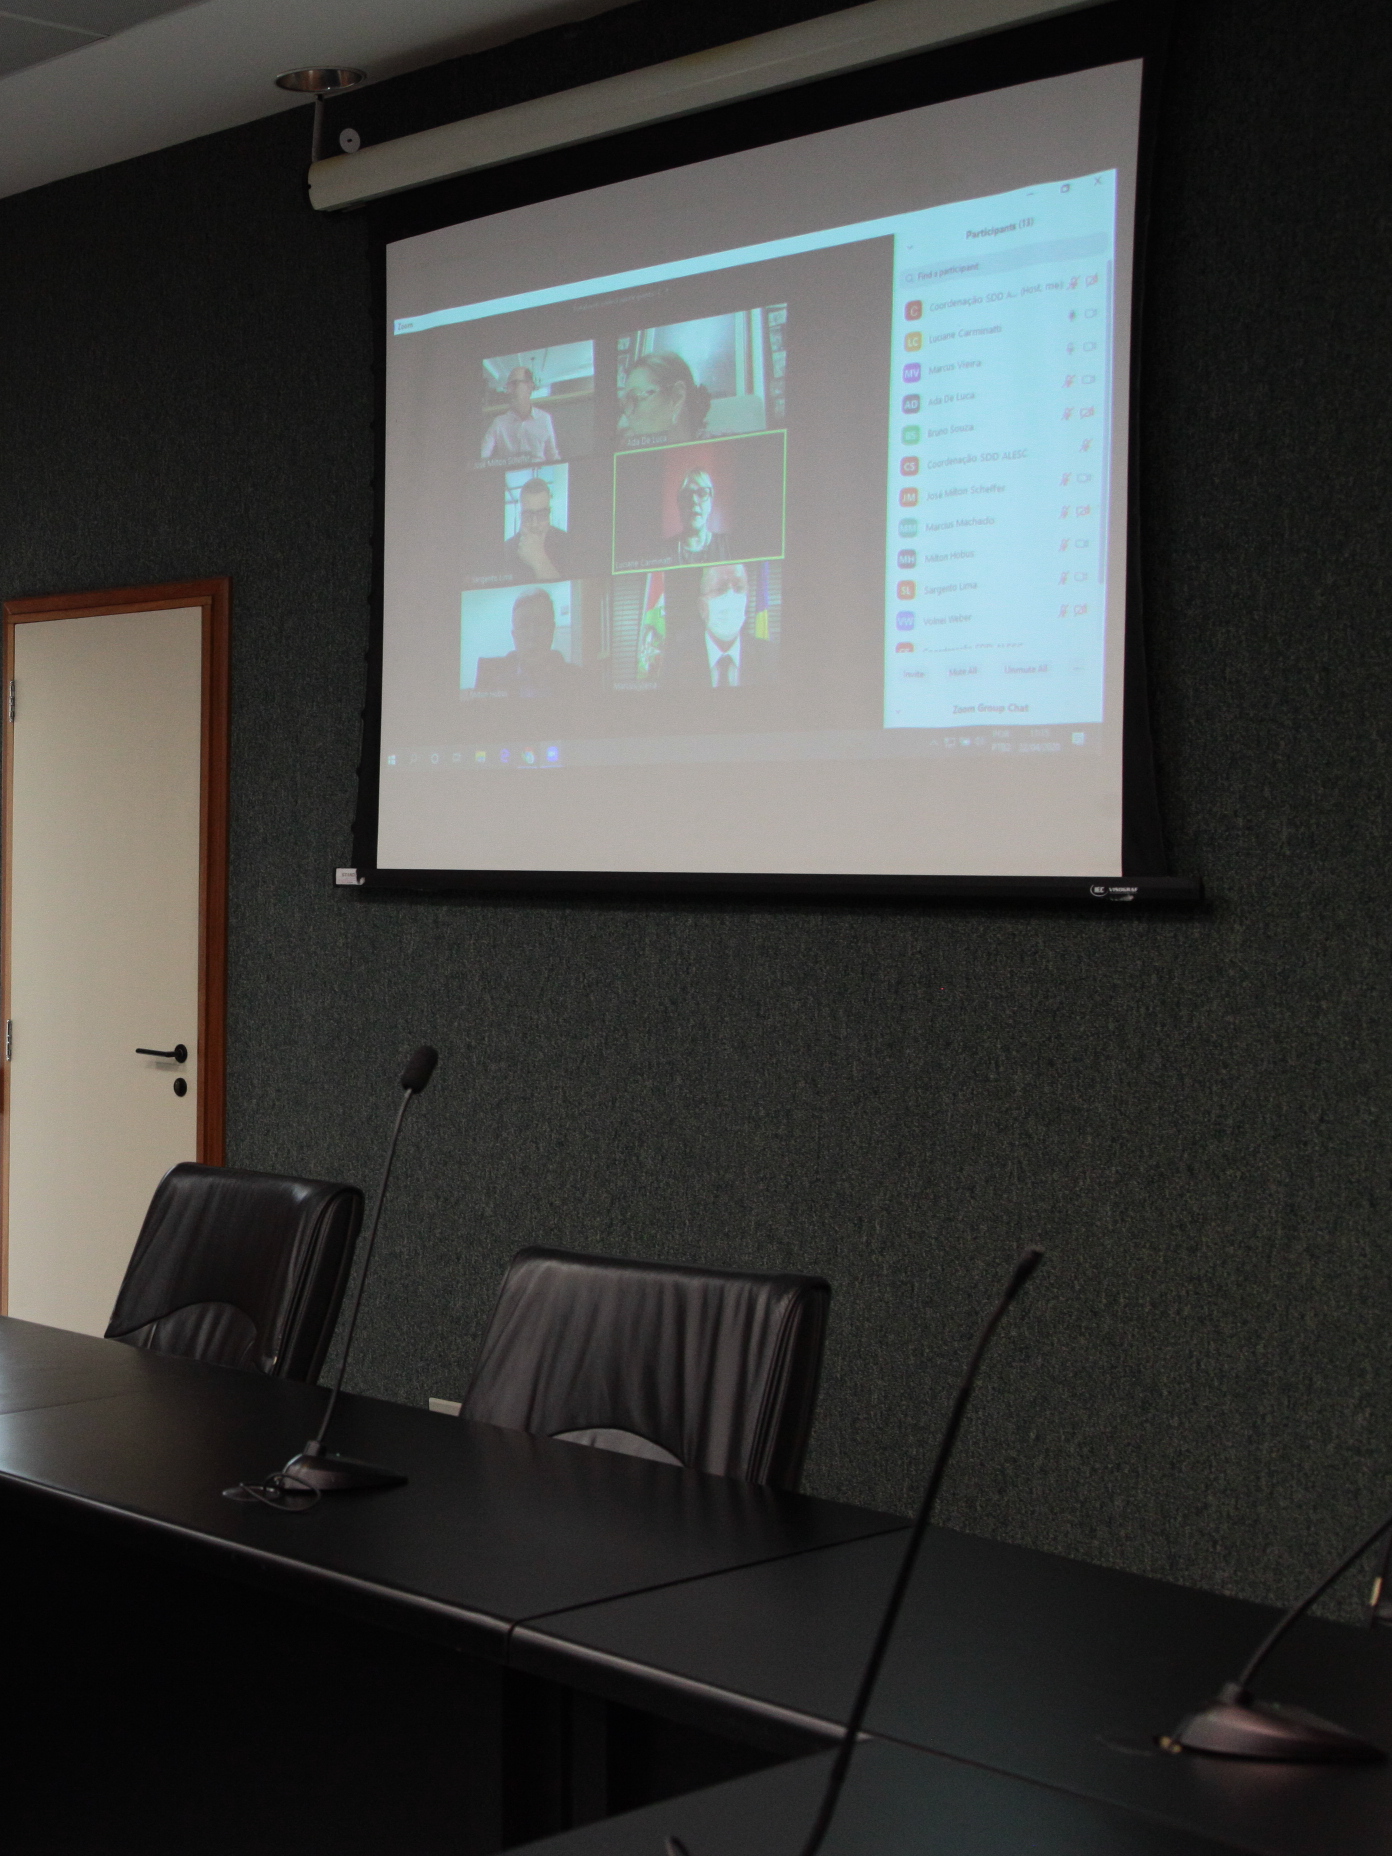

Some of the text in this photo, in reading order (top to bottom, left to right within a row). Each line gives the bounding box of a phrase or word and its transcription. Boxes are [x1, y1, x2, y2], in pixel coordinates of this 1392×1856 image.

[965, 222, 1016, 240] Participants
[917, 270, 933, 281] Find
[939, 262, 979, 278] participant
[909, 304, 919, 317] C
[928, 332, 956, 344] Luciane
[904, 368, 919, 379] MV
[927, 454, 977, 470] Coordenação
[952, 702, 1029, 715] Zoom Group Chat
